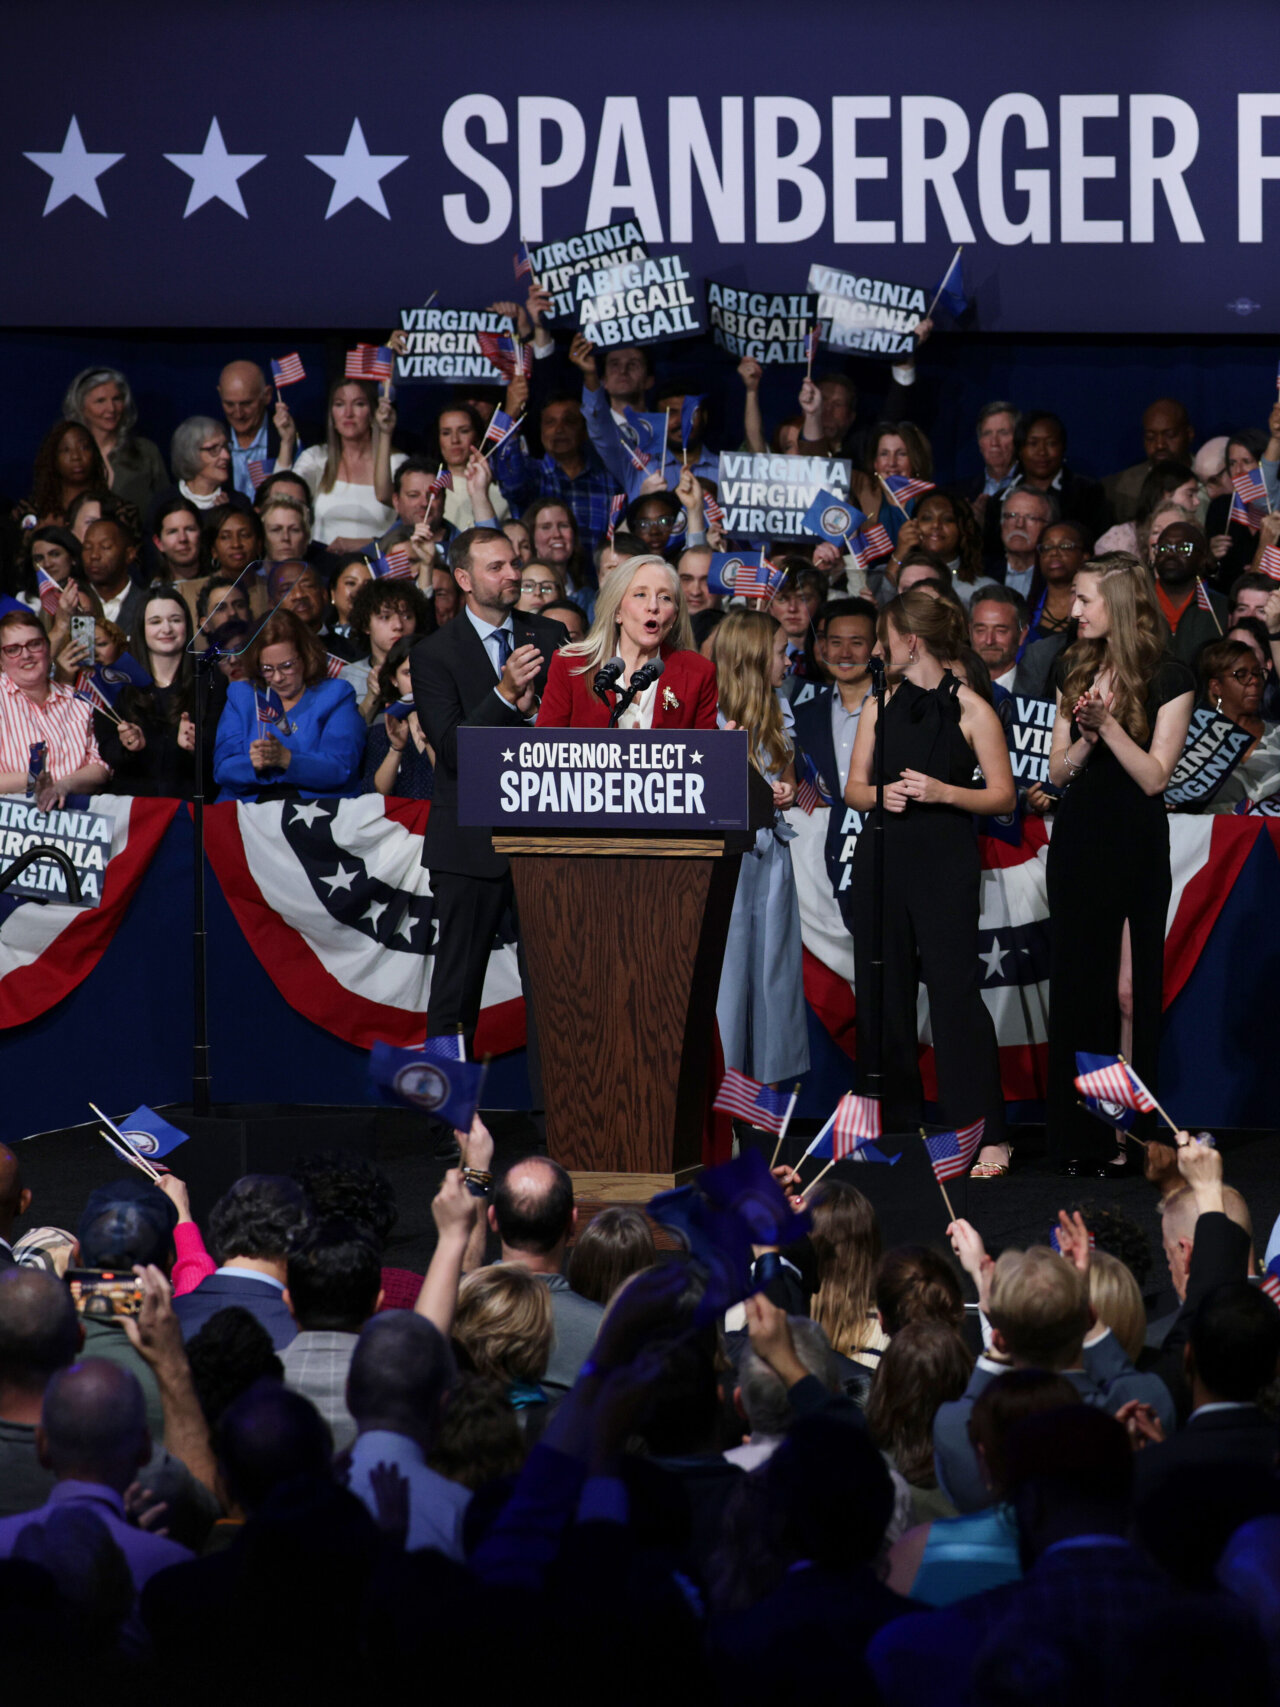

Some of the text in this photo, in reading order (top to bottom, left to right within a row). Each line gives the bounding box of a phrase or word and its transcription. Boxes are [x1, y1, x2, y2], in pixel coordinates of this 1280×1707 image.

[442, 92, 1205, 246] SPANBERGER
[529, 222, 643, 272] VIRGINIA
[576, 255, 690, 300] ABIGAIL
[813, 269, 926, 313] VIRGINIA
[580, 280, 695, 325] ABIGAIL
[708, 283, 814, 318] ABIGAIL
[401, 309, 514, 333] VIRGINIA
[584, 305, 700, 347] ABIGAIL
[711, 305, 807, 341] ABIGAIL
[820, 320, 914, 353] IRGINIA
[400, 332, 482, 354] VIRGIN
[723, 455, 848, 485] VIRGINIA
[721, 507, 818, 535] VIRGIN
[519, 742, 686, 770] GOVERNOR-ELECT
[500, 770, 706, 814] SPANBERGER
[0, 801, 109, 843] IRGINIA
